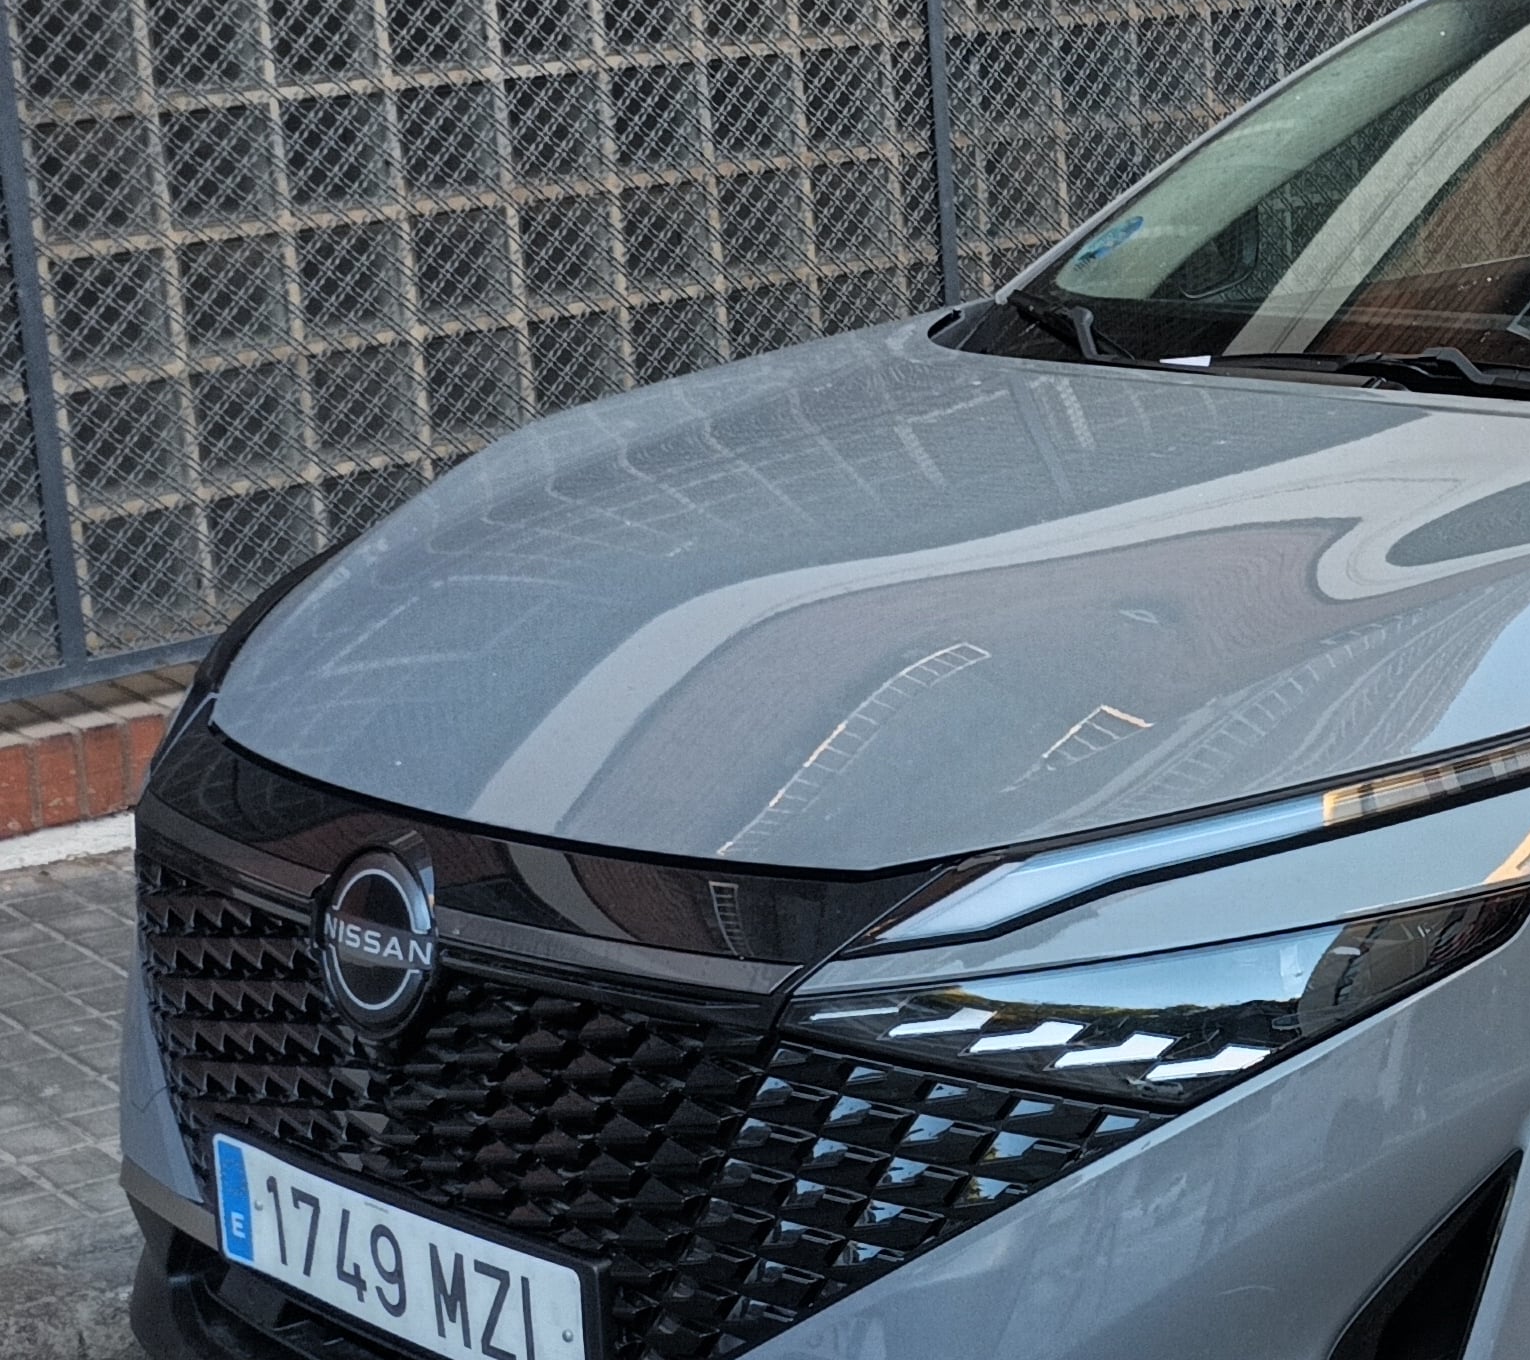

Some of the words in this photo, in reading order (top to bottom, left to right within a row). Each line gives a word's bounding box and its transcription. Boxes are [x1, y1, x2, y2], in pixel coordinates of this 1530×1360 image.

[324, 912, 433, 965] NISSAN
[231, 1210, 247, 1240] E
[265, 1175, 407, 1317] 1749
